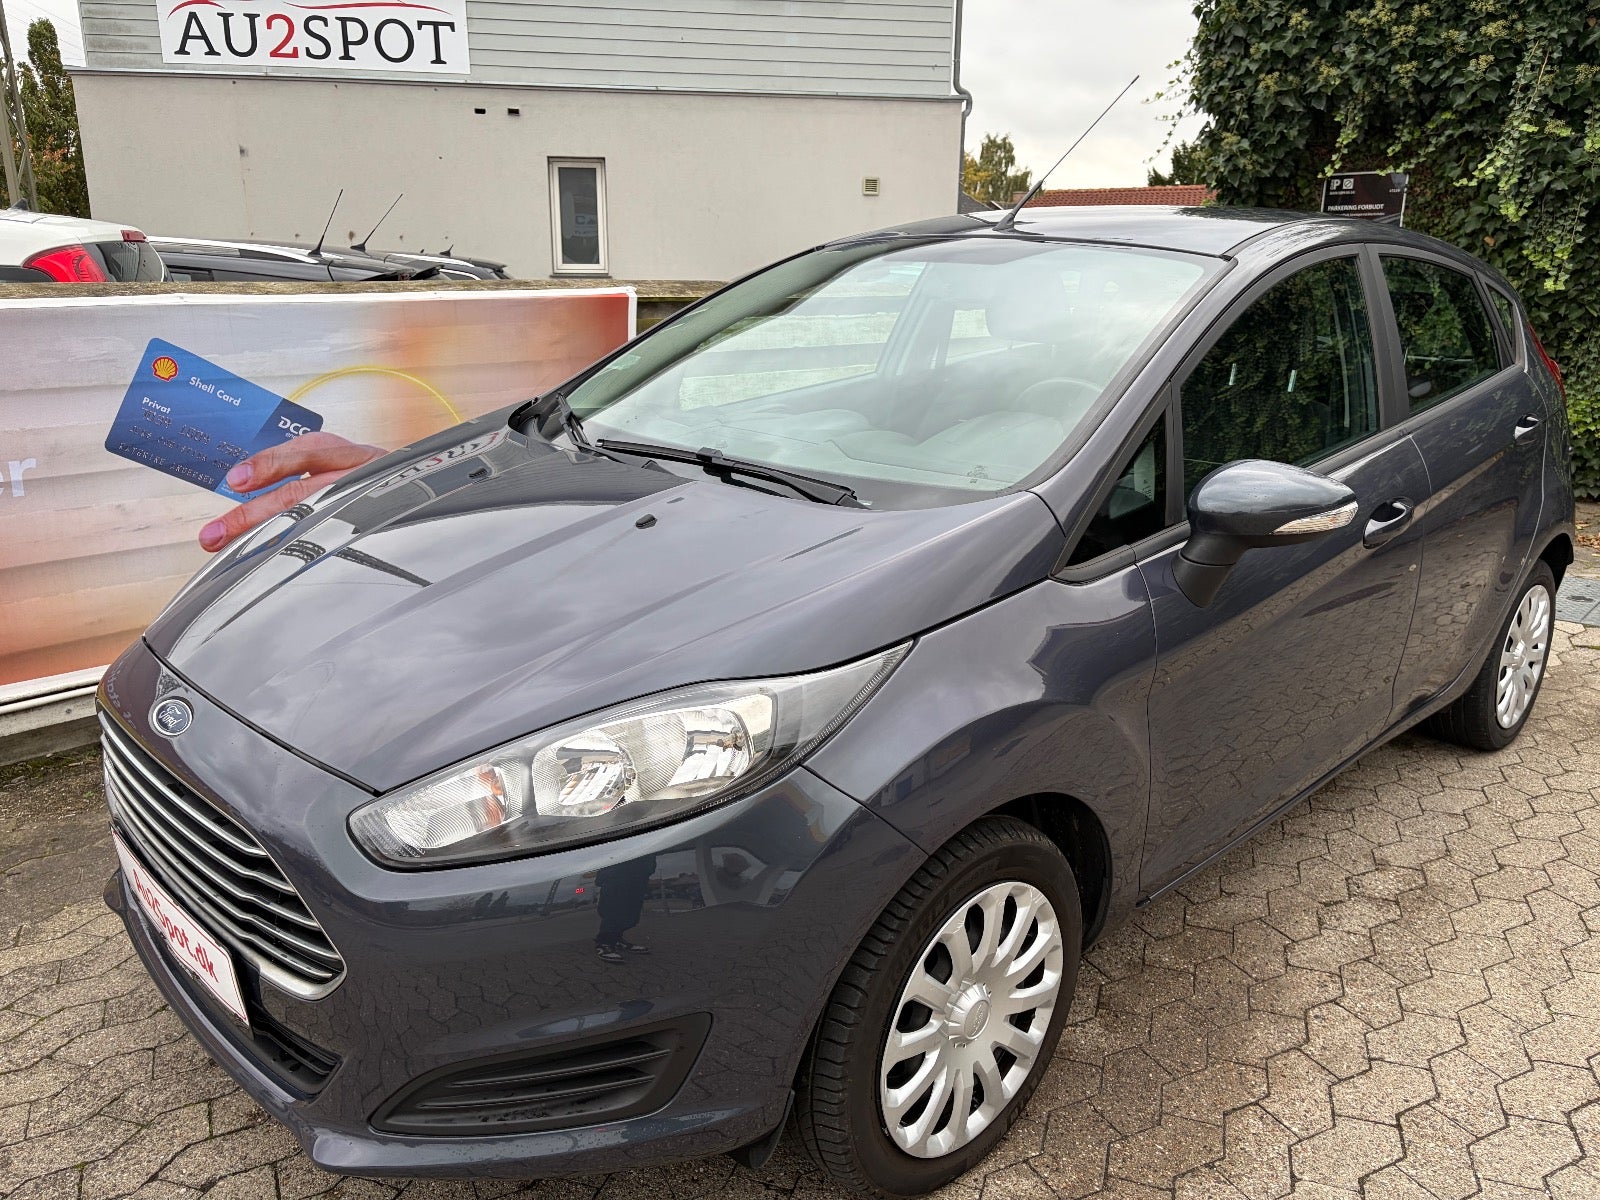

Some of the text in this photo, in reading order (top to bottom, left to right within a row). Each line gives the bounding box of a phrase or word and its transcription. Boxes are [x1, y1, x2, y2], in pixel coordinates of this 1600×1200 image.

[174, 11, 455, 64] AU2SPOT
[1327, 203, 1385, 212] PARKERING FORBUDT
[189, 376, 242, 407] Shell Card
[142, 396, 172, 414] Privat
[278, 415, 311, 435] DCC
[158, 704, 183, 729] Ford
